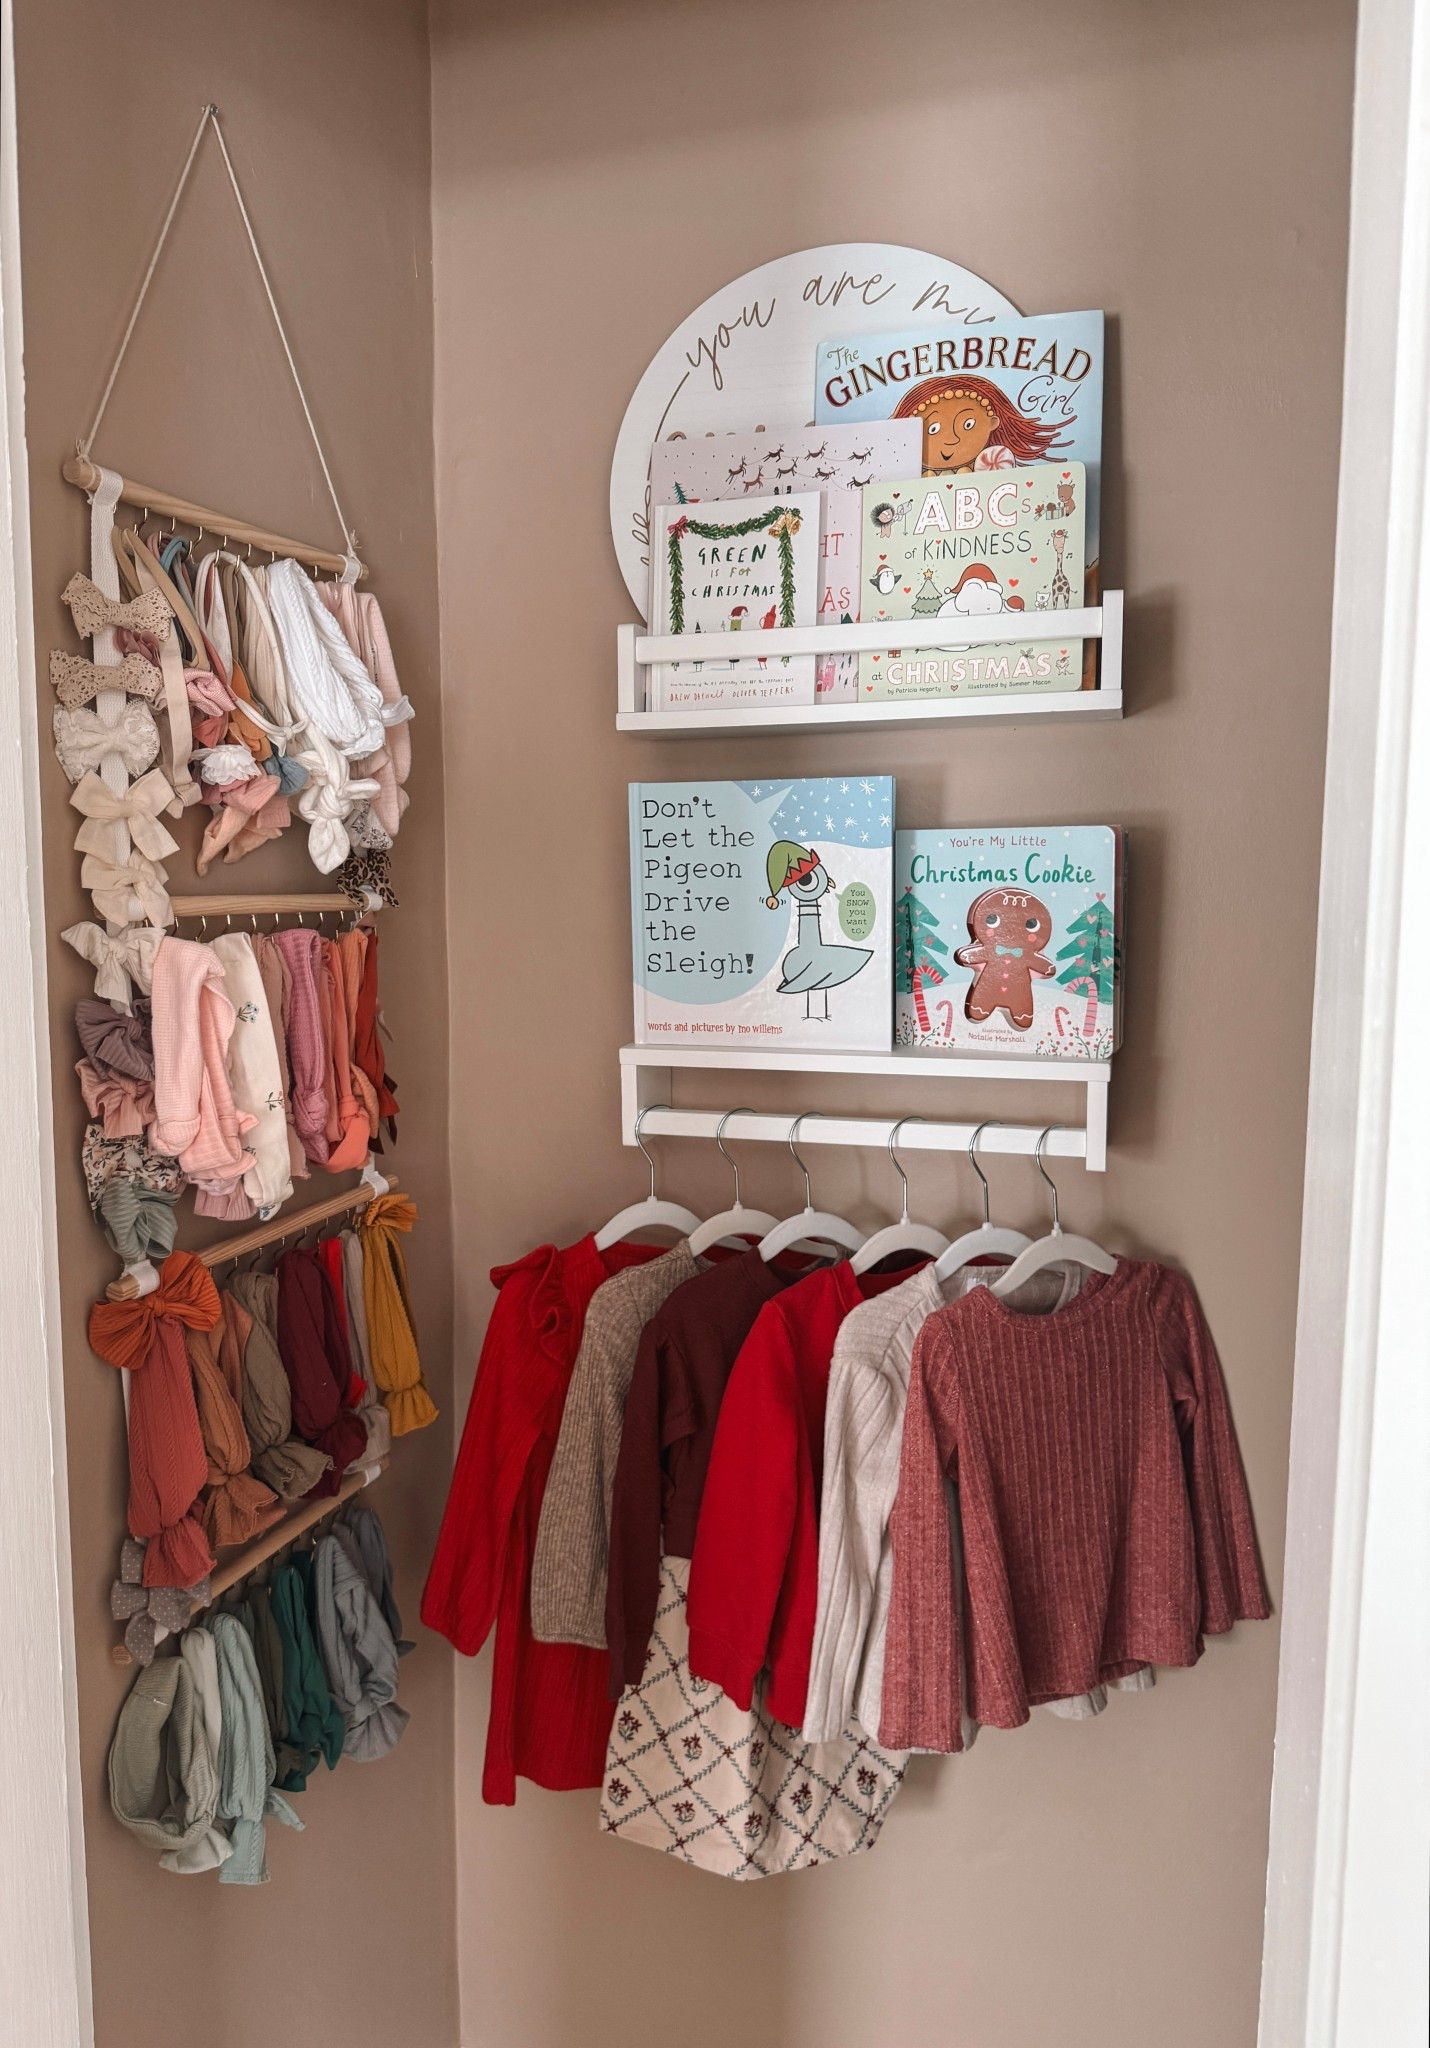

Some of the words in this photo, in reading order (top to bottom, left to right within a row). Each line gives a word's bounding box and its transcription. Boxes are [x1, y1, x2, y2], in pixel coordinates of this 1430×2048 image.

[686, 298, 776, 391] you
[803, 271, 896, 307] are
[826, 345, 859, 370] The
[824, 336, 1093, 408] GINGERBREAD
[1017, 375, 1082, 416] Girl
[698, 543, 767, 566] GREEN
[904, 547, 917, 560] of
[691, 584, 776, 599] CHRISTMAS
[871, 671, 883, 682] at
[886, 652, 1052, 686] CHRISTMAS
[642, 796, 716, 819] Don't
[642, 828, 694, 848] Let
[708, 825, 755, 847] the
[949, 836, 984, 848] You're
[990, 836, 1005, 848] My
[1011, 835, 1047, 847] Little
[644, 856, 742, 884] Pigeon
[910, 854, 1018, 884] Christmas
[1024, 852, 1096, 884] Cookie
[644, 889, 730, 912] Drive
[846, 899, 870, 907] SNOW
[850, 889, 866, 897] You
[846, 918, 867, 926] want
[849, 909, 866, 918] you
[646, 920, 696, 941] the
[647, 950, 754, 980] Sleigh!
[647, 1022, 672, 1031] words
[674, 1022, 688, 1032] and
[691, 1022, 724, 1034] pictures
[725, 1023, 736, 1034] by
[752, 1024, 783, 1034] willems
[967, 1032, 993, 1042] Natalie
[995, 1035, 1026, 1043] Marshall
